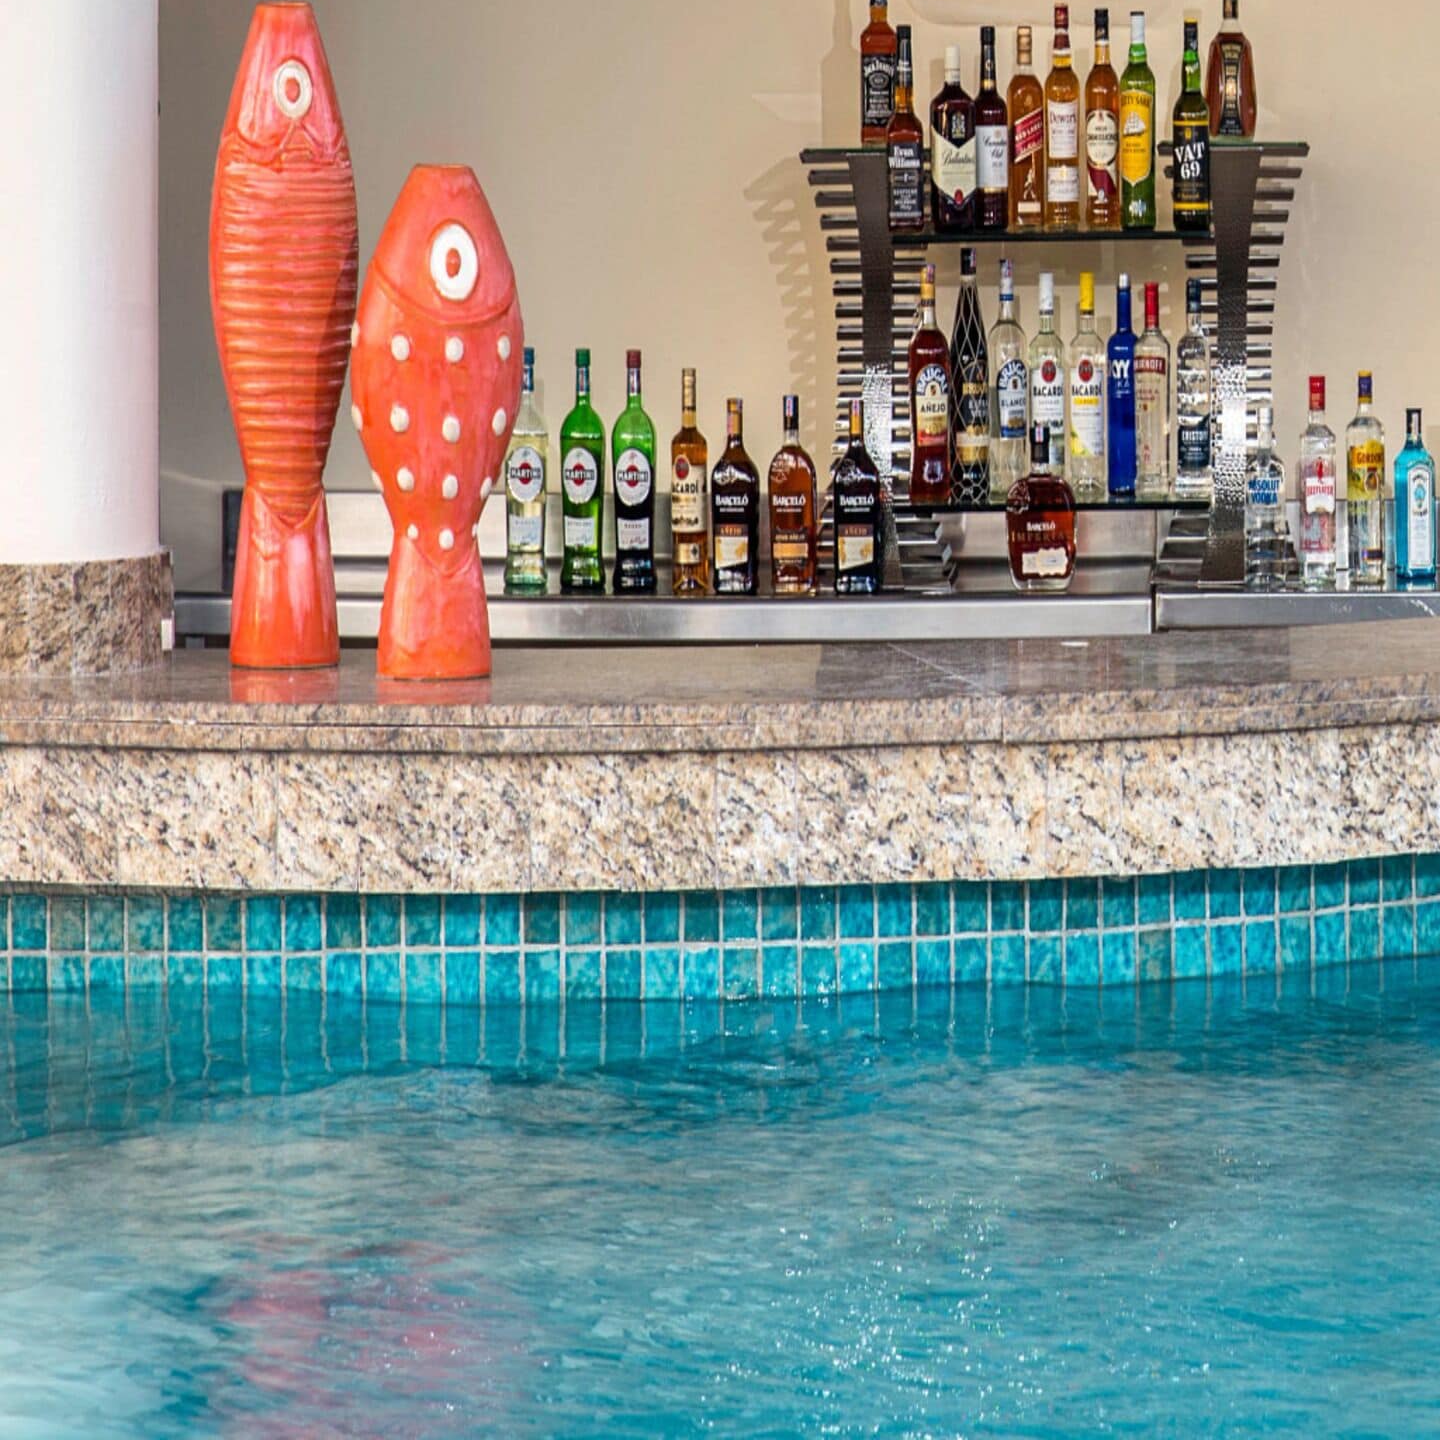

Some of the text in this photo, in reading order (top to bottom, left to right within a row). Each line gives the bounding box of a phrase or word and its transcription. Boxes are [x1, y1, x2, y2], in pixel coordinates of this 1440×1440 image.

[893, 145, 914, 157] Evan
[1175, 141, 1205, 163] VAT
[888, 157, 921, 169] Williams
[1181, 161, 1201, 179] 69
[715, 494, 749, 506] BARCELÓ
[772, 494, 806, 506] BARCELÓ
[840, 494, 874, 506] BARCELÓ
